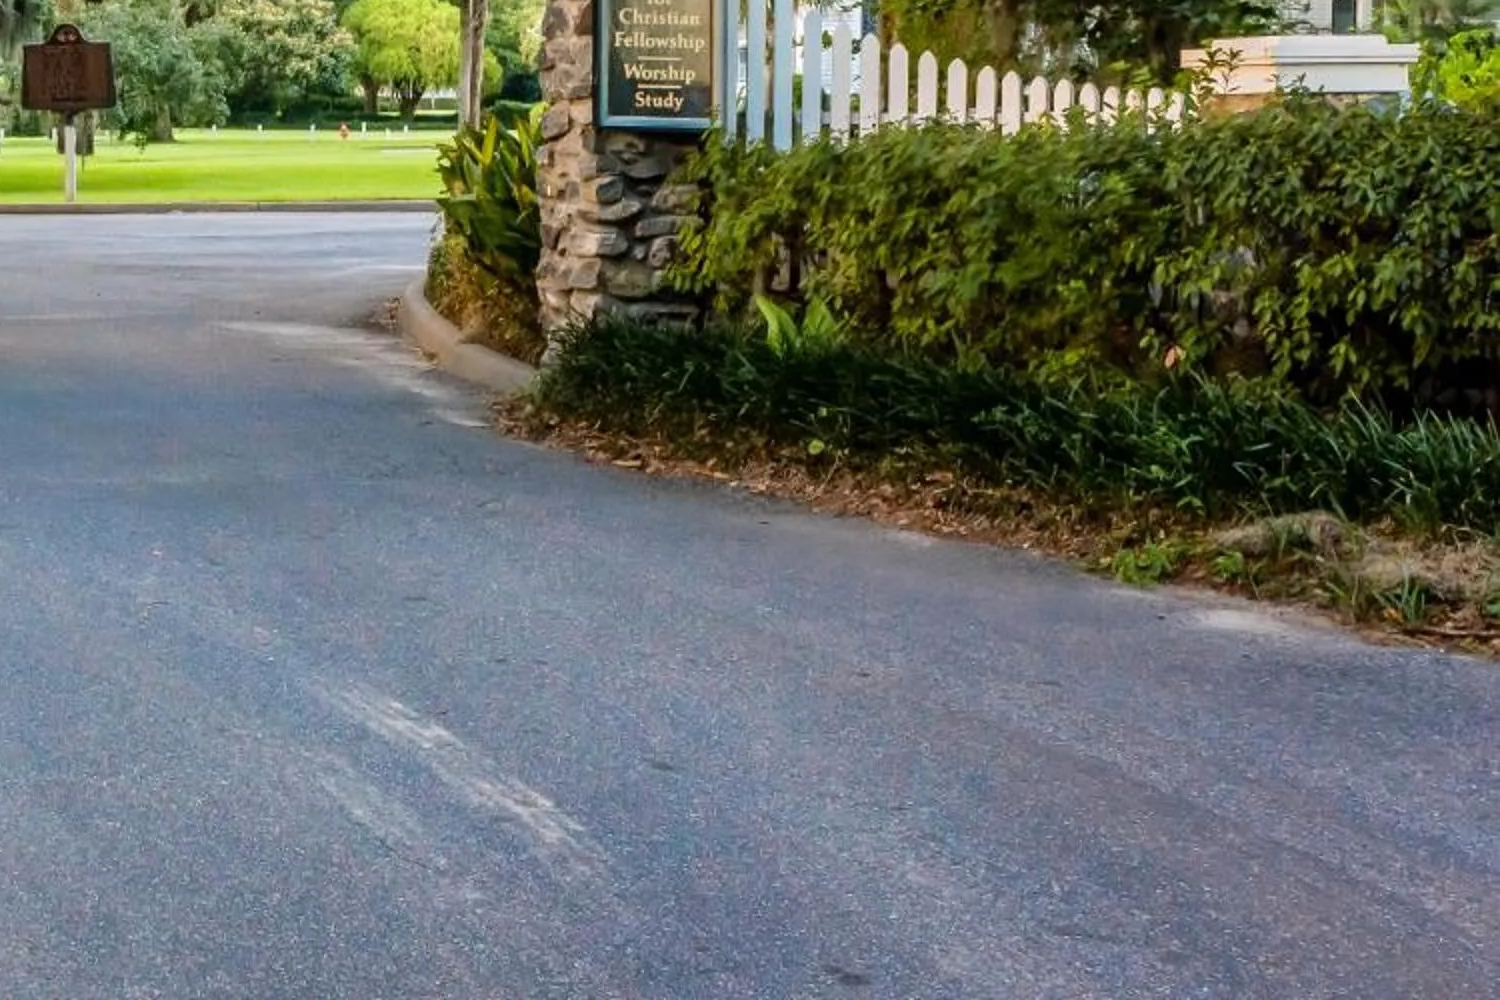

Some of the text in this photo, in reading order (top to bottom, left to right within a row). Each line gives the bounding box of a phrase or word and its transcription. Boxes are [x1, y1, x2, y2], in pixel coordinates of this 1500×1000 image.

[618, 7, 701, 26] Christian
[614, 31, 706, 54] Fellowship
[623, 63, 697, 84] Worship
[634, 91, 685, 112] Study
